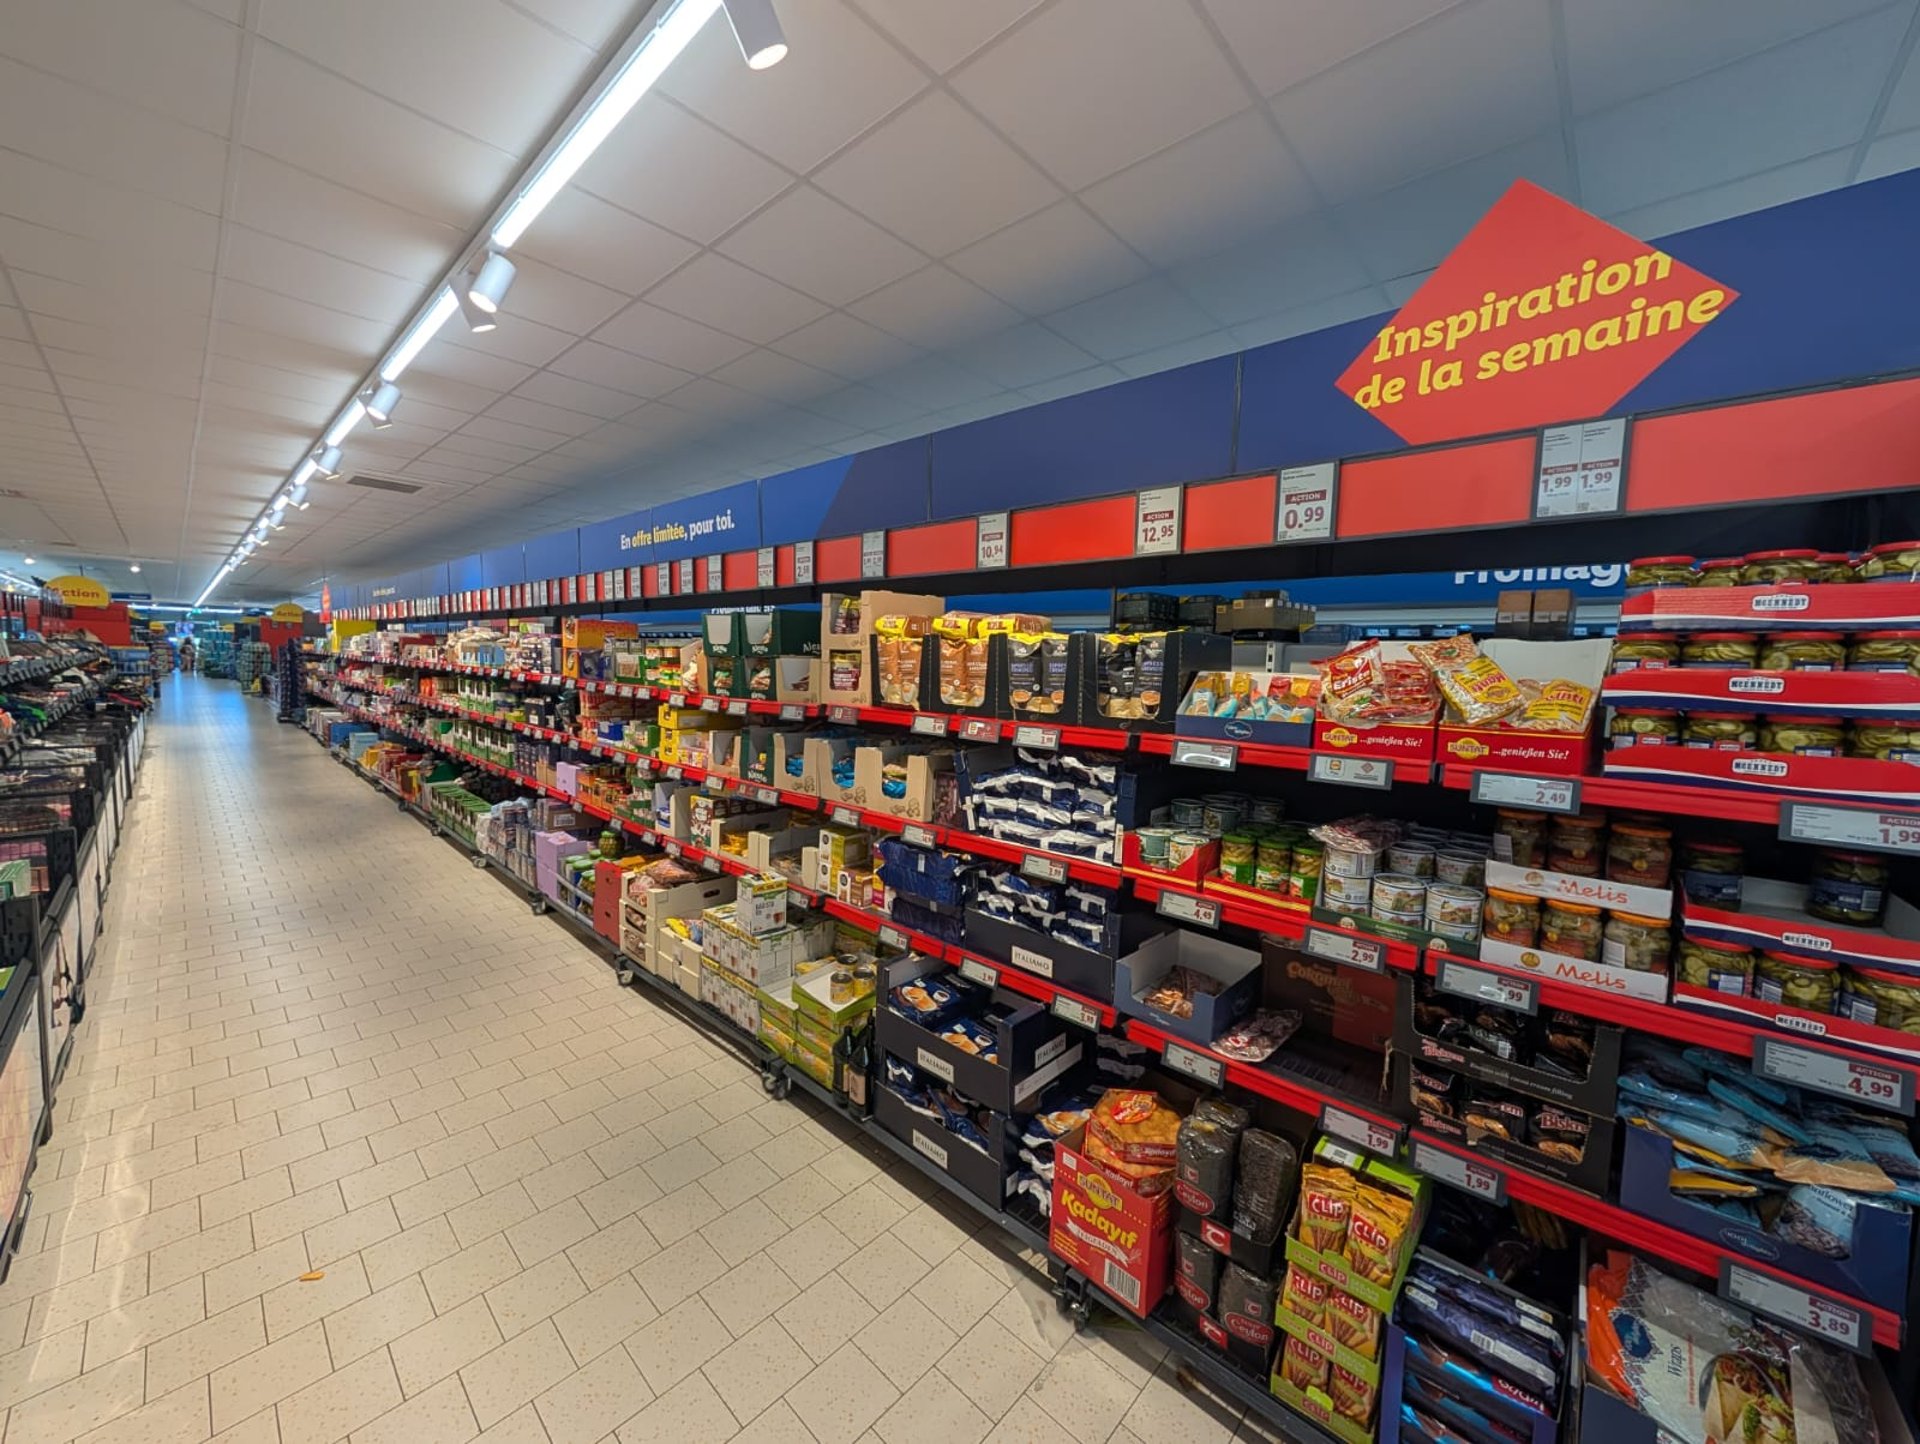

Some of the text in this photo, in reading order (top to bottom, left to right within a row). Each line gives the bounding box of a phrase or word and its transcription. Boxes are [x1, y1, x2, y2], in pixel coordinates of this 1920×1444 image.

[1371, 250, 1673, 363] Inspiration
[1353, 288, 1725, 411] de la semaine
[1542, 476, 1572, 493] 1.99
[1581, 472, 1612, 490] 1.99
[620, 509, 735, 550] En offre limitée, pour toi.
[1285, 506, 1324, 530] 0.99
[1142, 524, 1174, 543] 12.95
[1454, 564, 1630, 588] Fromag
[1547, 748, 1570, 760] Sie!
[1536, 790, 1566, 805] 2.49
[1557, 880, 1628, 904] Melis
[1352, 950, 1375, 963] 2.99
[1556, 963, 1627, 990] Melis
[1848, 1077, 1894, 1099] 4.99
[1367, 1133, 1389, 1149] 1.99
[1465, 1173, 1490, 1191] 1.99
[1230, 1318, 1270, 1343] Ceylon
[1808, 1309, 1851, 1335] 3.89
[1667, 1344, 1686, 1377] Wraps
